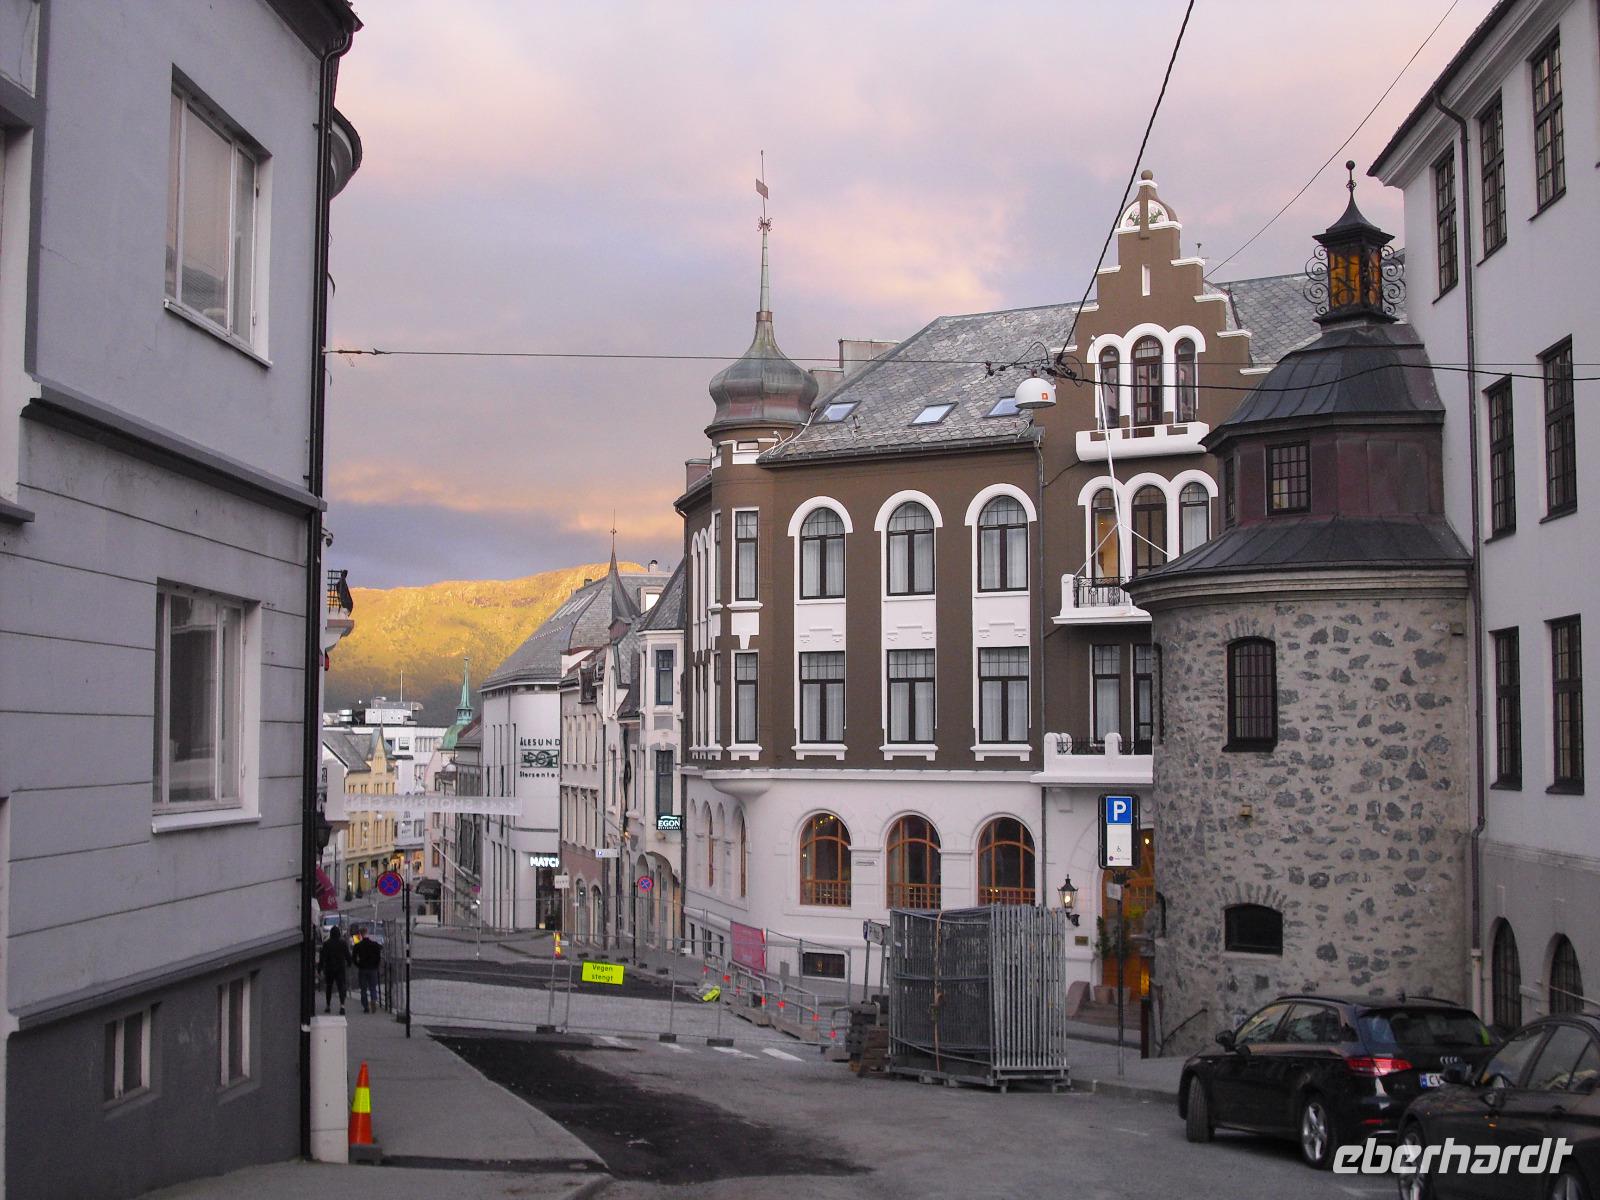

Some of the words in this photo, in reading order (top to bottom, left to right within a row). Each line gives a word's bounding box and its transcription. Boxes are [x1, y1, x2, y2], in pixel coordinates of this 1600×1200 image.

[1113, 800, 1127, 822] P
[657, 819, 681, 828] EGON
[592, 964, 614, 973] Vegen
[591, 974, 614, 983] stengt
